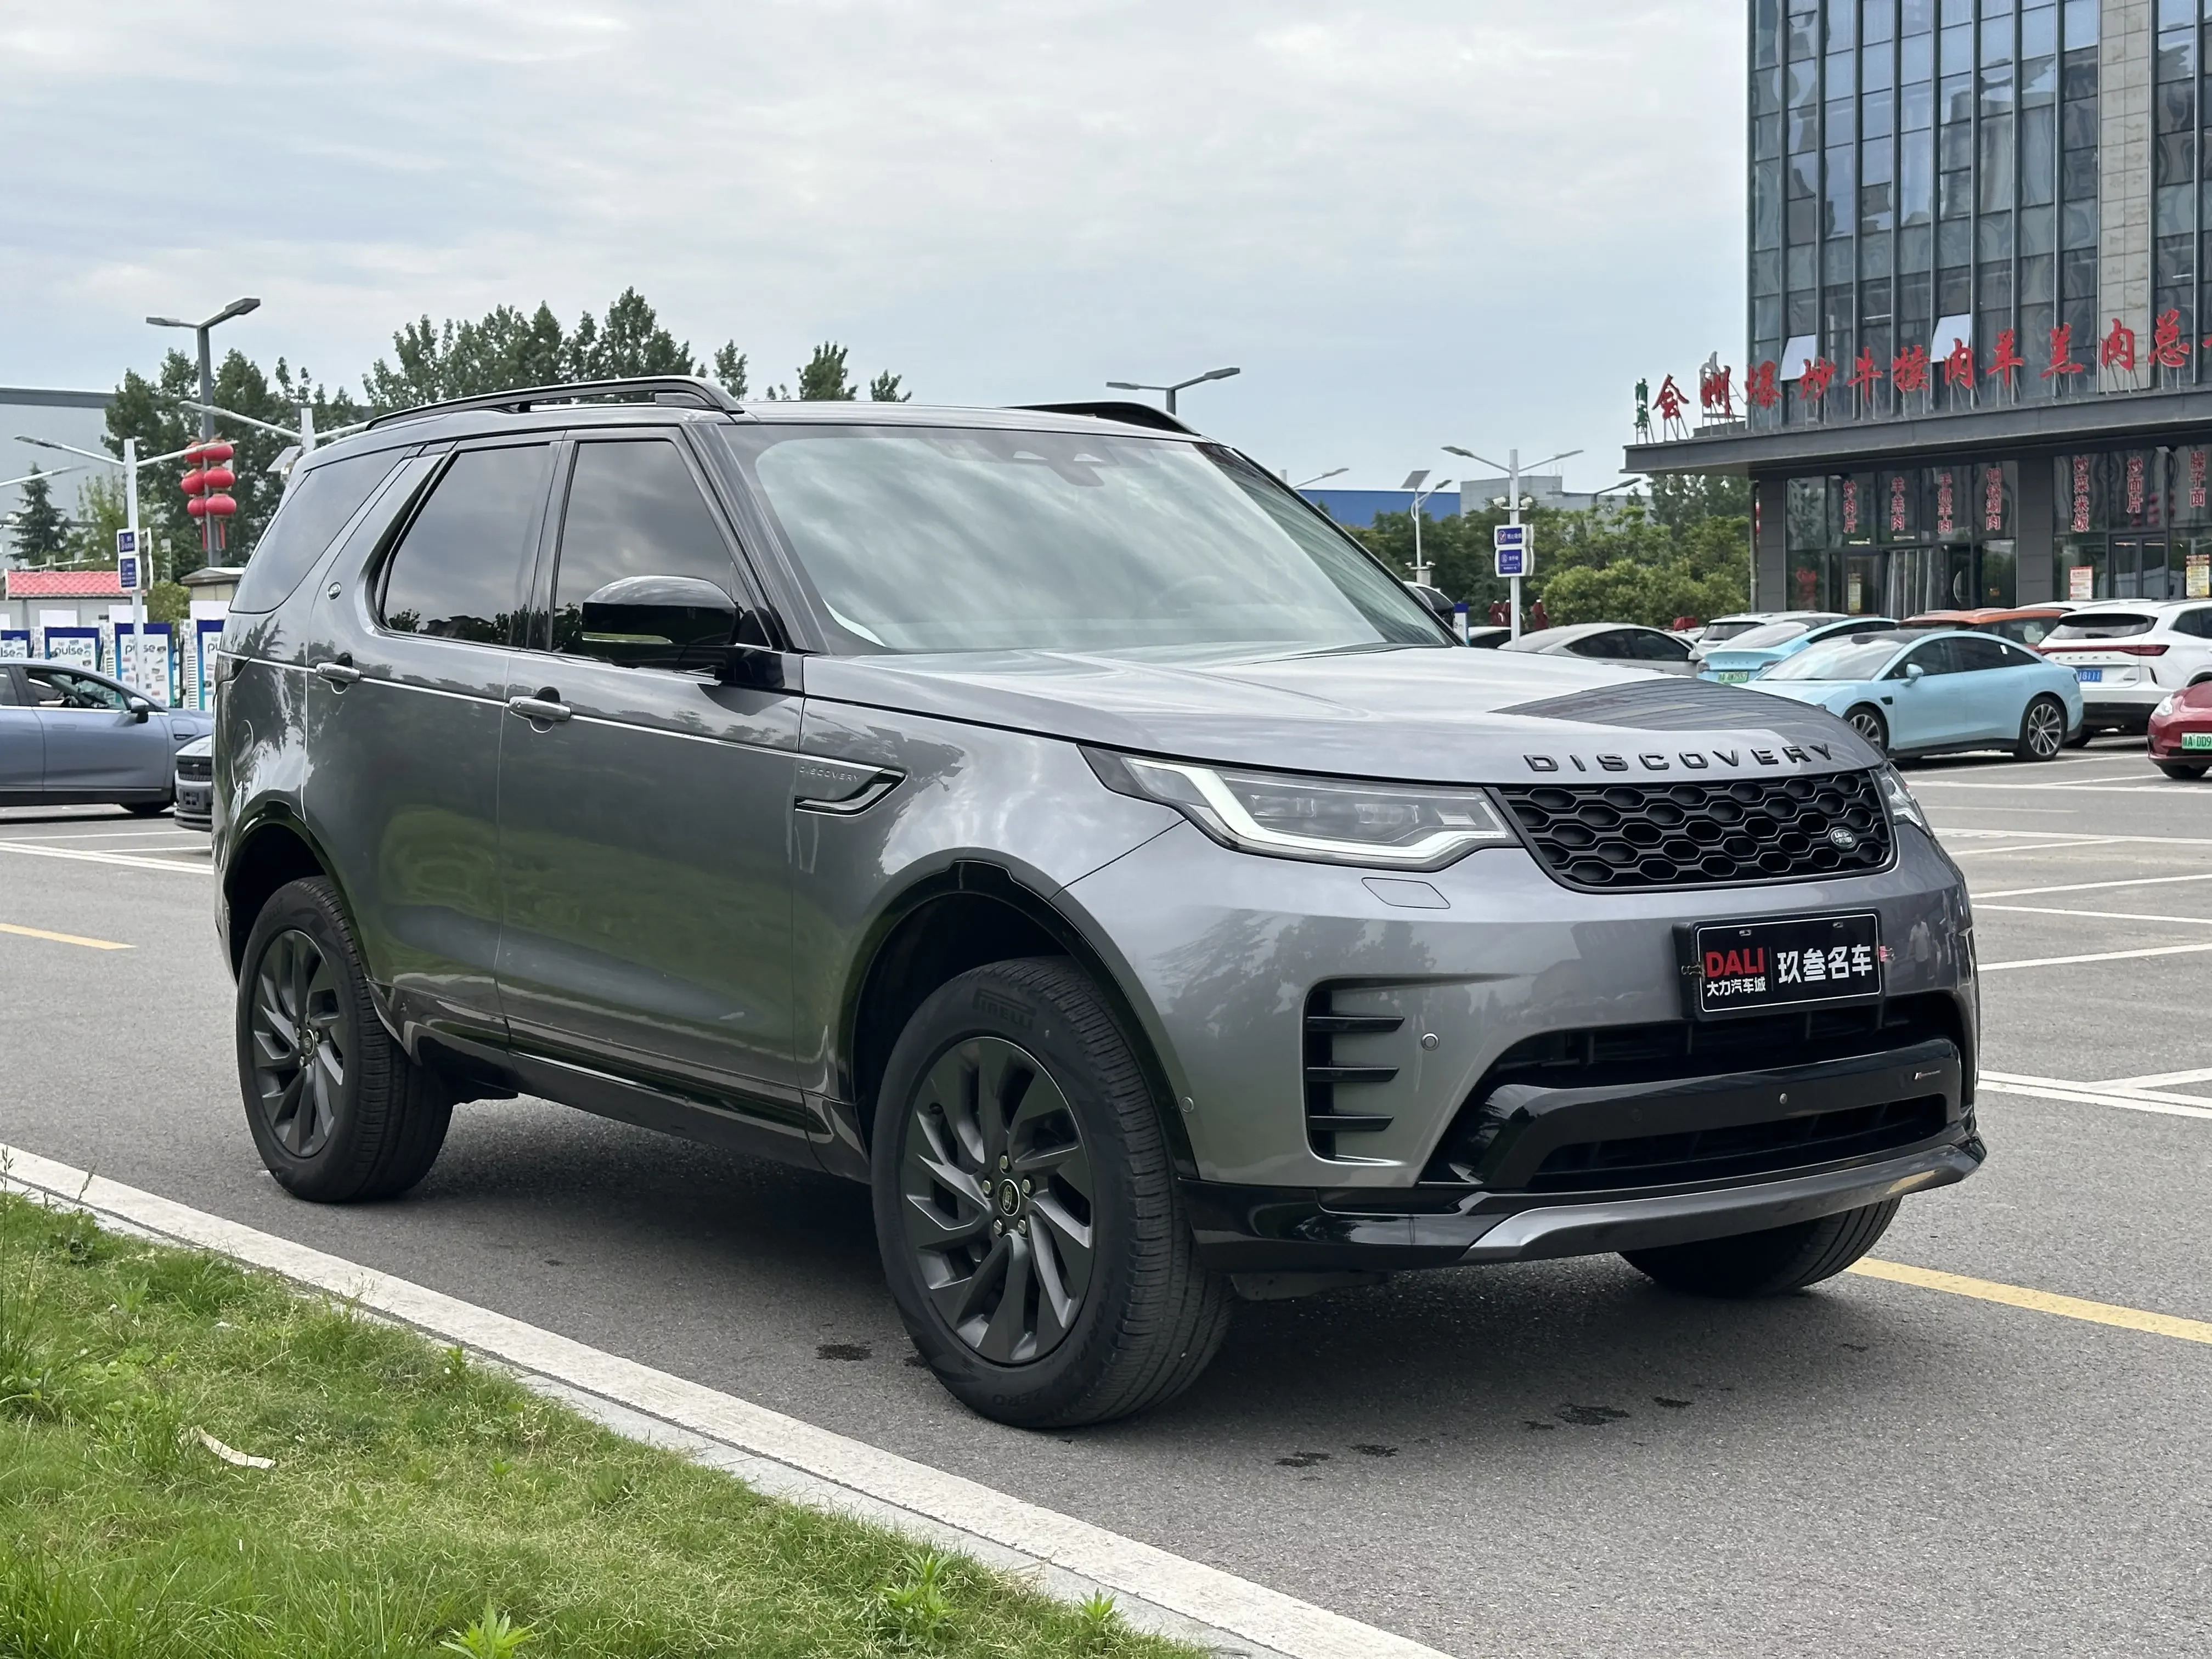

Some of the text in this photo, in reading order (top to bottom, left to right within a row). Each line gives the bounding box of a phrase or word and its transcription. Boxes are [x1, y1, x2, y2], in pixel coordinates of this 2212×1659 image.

[1651, 308, 2212, 418] 会州爆炒牛犊肉羊羔肉总
[2127, 456, 2143, 514] 炒面片
[799, 766, 860, 782] DISCOVERY
[1523, 743, 1833, 772] DISCOVERY
[1705, 947, 1765, 978] DALI
[1777, 944, 1872, 984] 玖叁名车
[1707, 977, 1767, 997] 大力汽车城
[972, 987, 1037, 1031] PIRELLI
